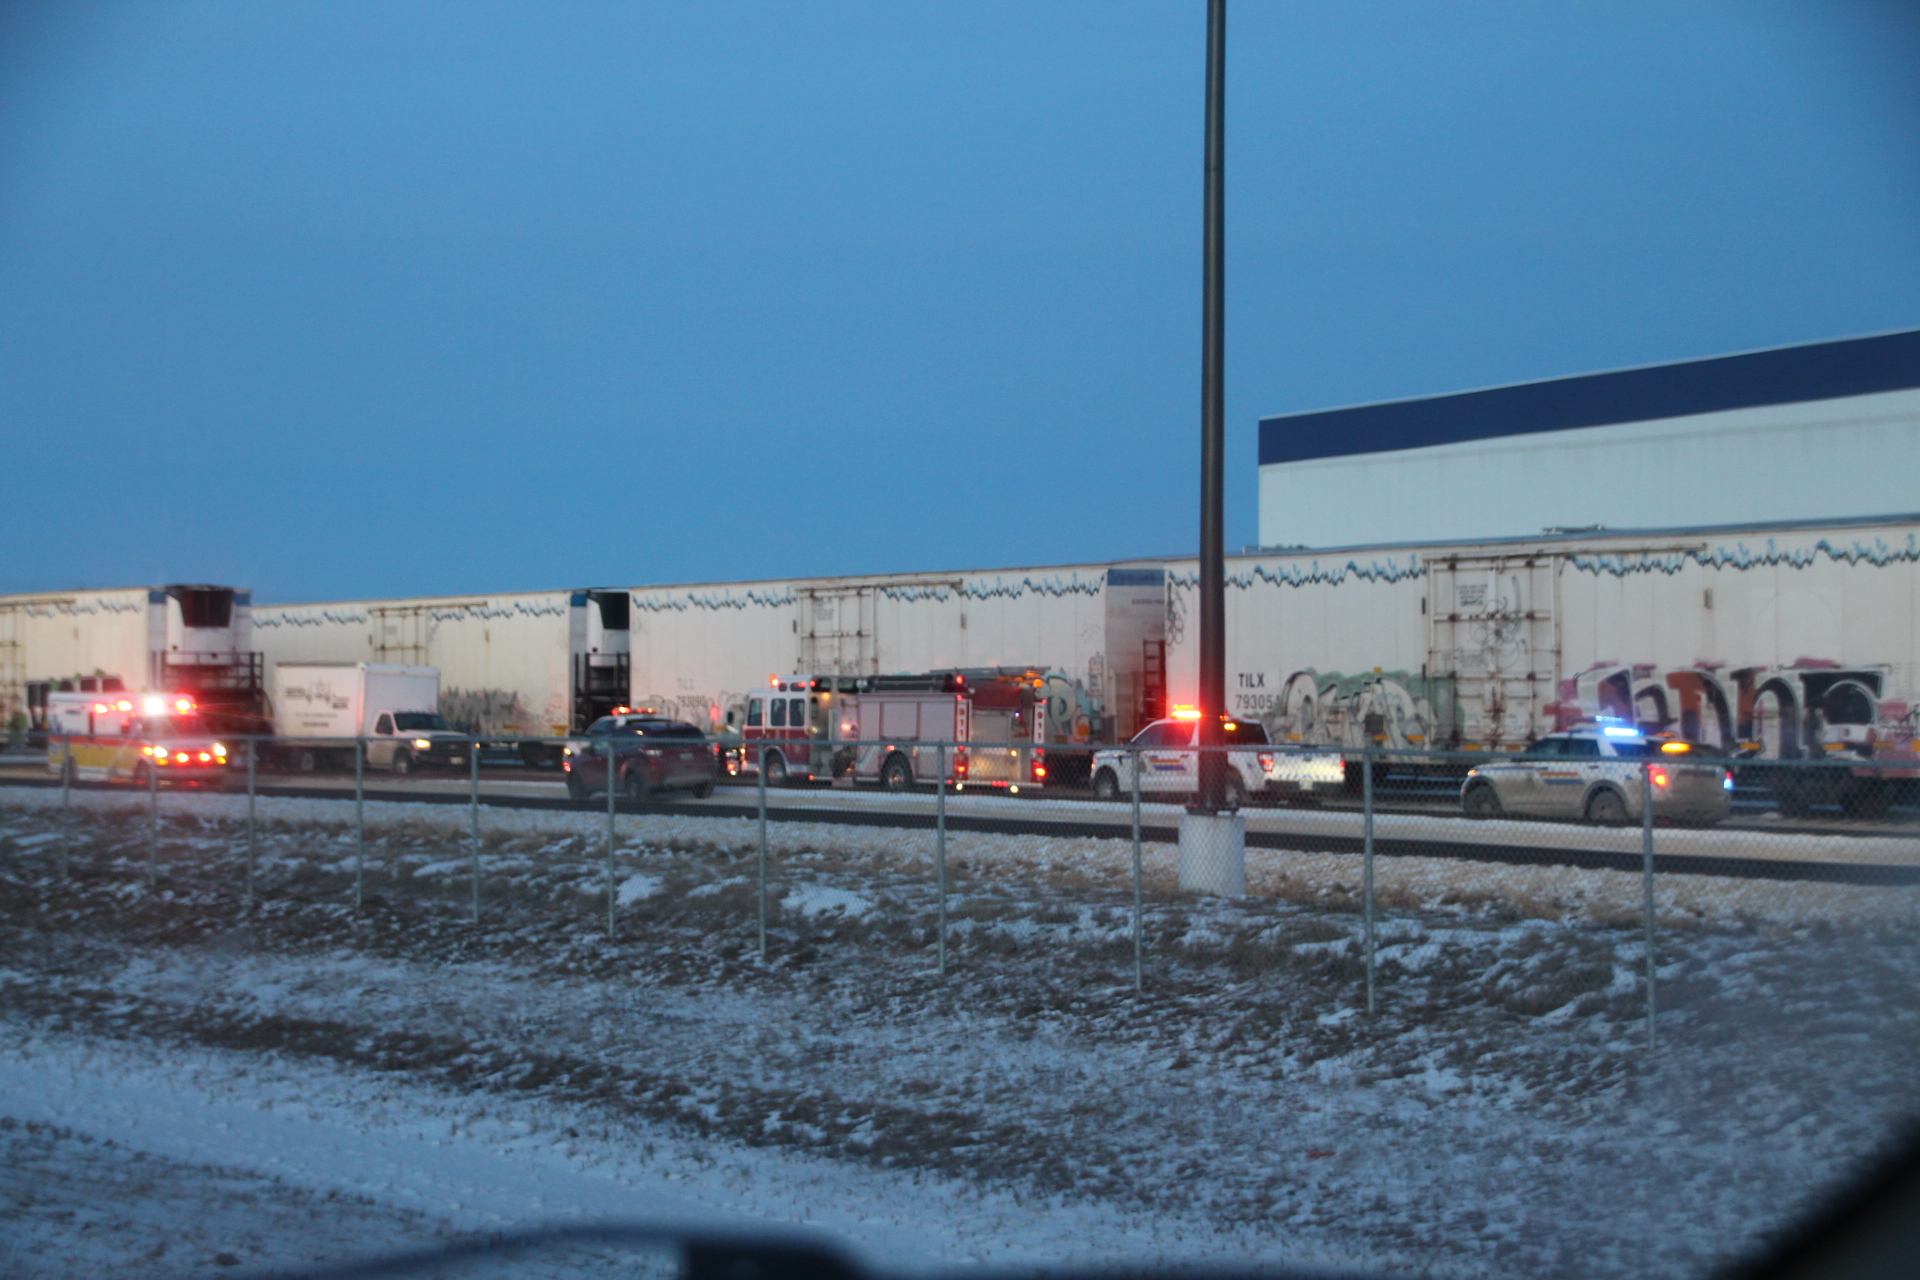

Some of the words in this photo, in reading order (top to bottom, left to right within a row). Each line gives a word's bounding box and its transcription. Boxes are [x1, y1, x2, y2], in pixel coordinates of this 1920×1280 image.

[1238, 672, 1265, 688] TILX
[958, 708, 966, 737] 911
[1036, 711, 1044, 740] 911
